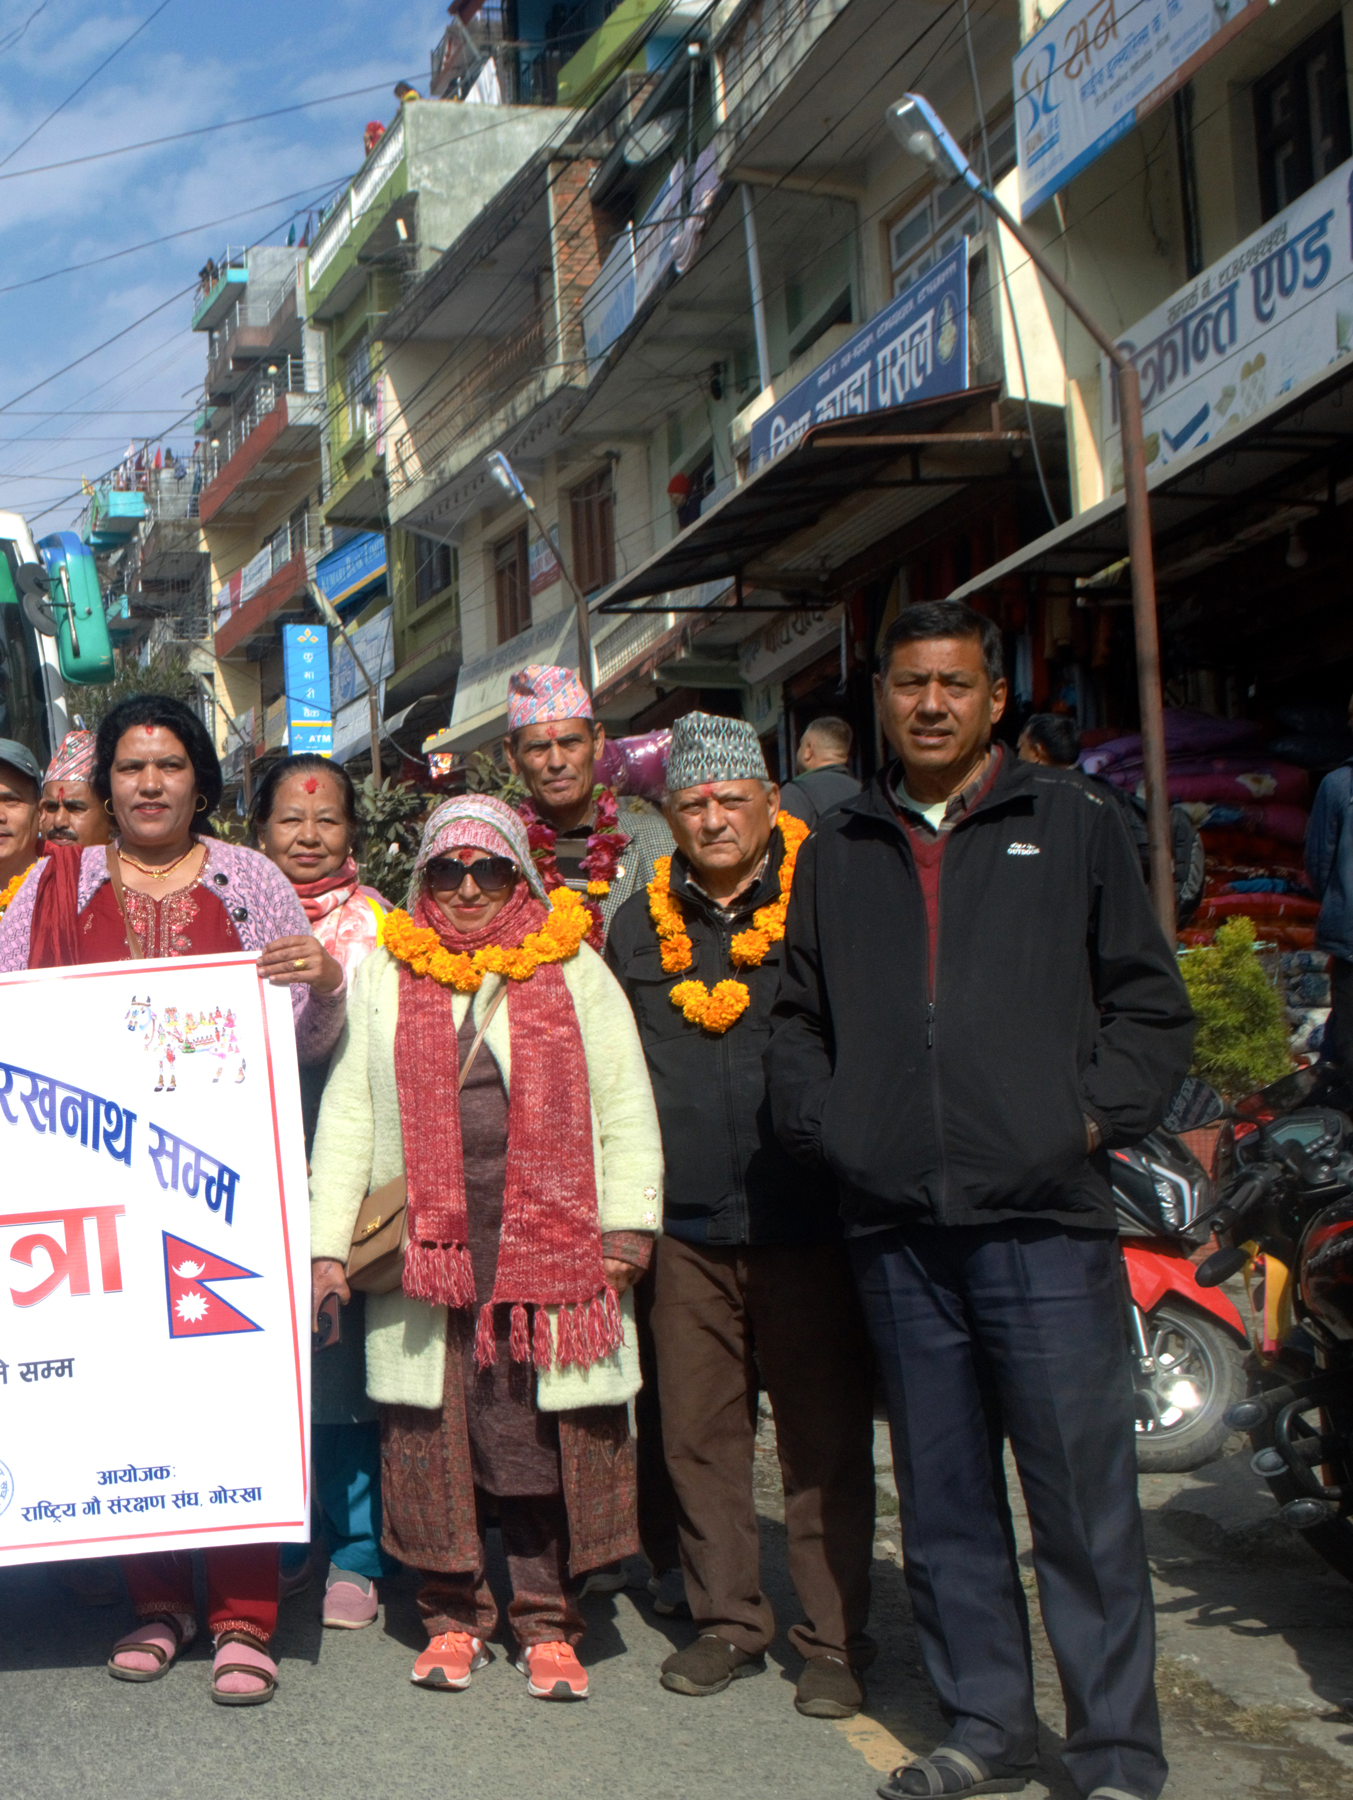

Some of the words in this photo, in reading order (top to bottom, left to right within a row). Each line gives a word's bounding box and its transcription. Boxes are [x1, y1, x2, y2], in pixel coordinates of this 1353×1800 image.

[1251, 208, 1335, 325] एण्ड
[308, 734, 331, 743] ATM
[149, 1121, 241, 1227] सम्म
[18, 1357, 75, 1384] सम्म
[21, 1500, 76, 1523] राष्ट्रिय
[82, 1495, 101, 1516] गौ
[106, 1495, 166, 1515] संरक्षण
[208, 1485, 262, 1505] गोरखा
